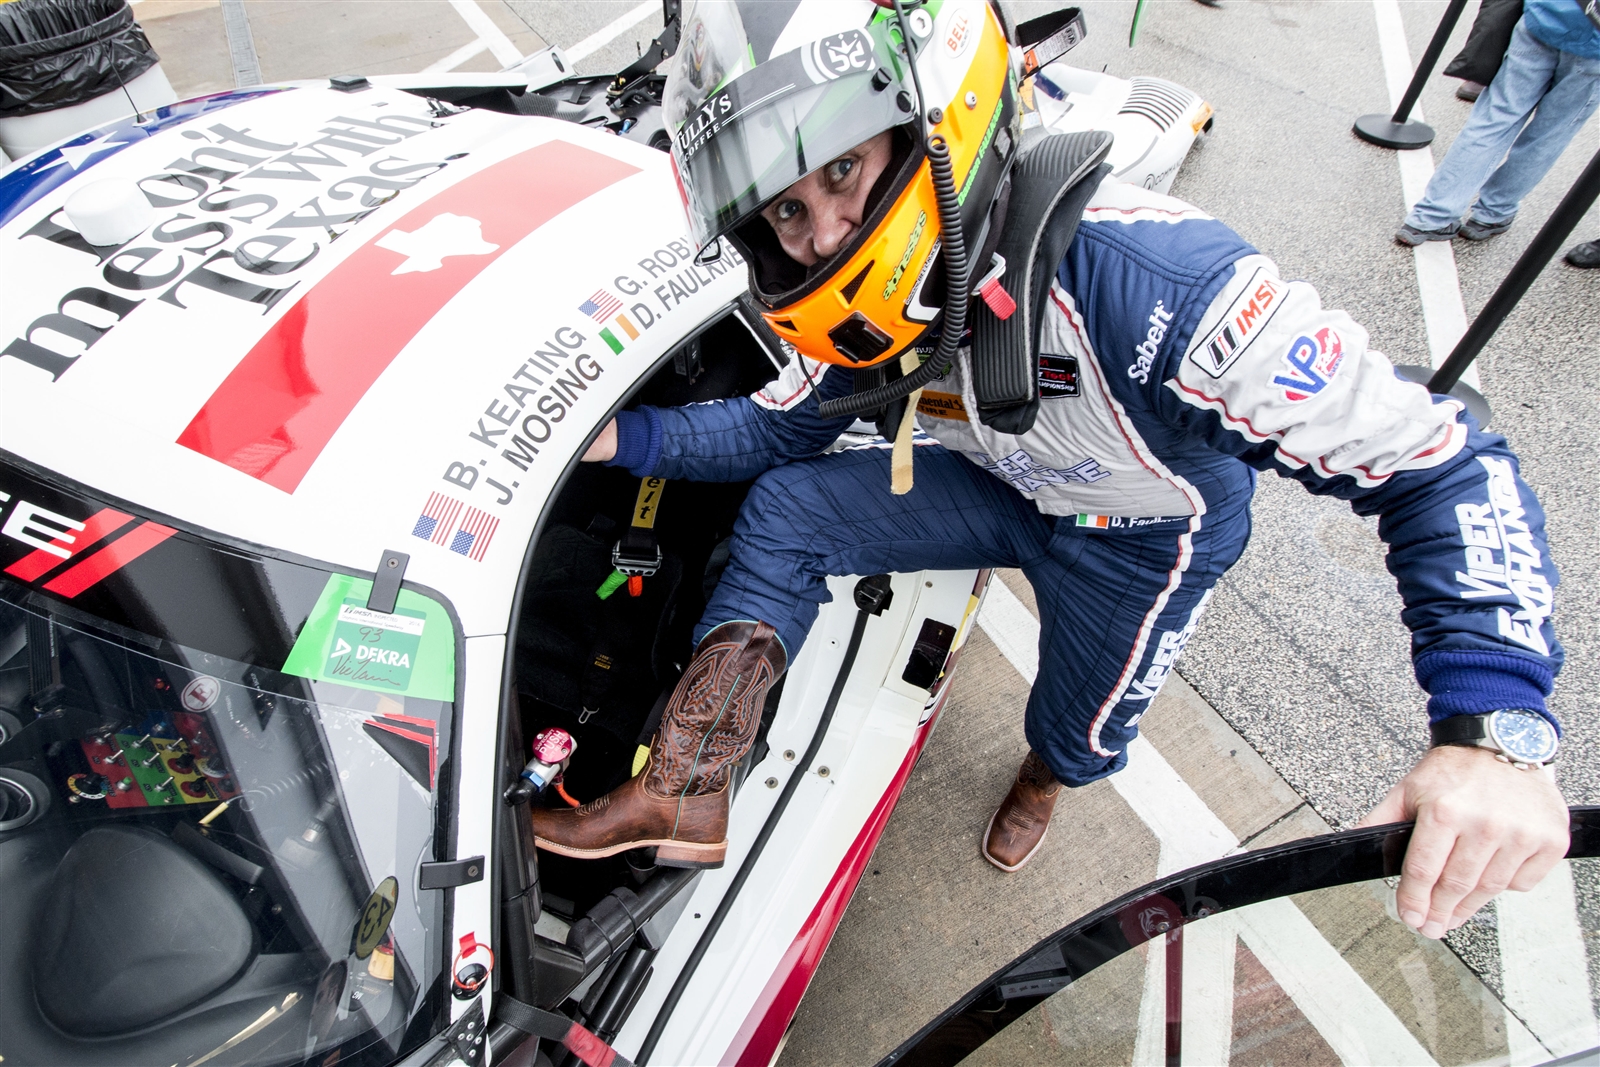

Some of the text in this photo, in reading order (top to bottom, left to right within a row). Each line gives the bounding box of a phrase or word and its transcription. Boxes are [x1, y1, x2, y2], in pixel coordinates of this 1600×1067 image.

[947, 15, 968, 51] BELL
[684, 122, 721, 161] COFFEE
[0, 115, 449, 383] mess with
[157, 152, 470, 316] Texas.
[614, 276, 648, 295] G.
[630, 244, 745, 330] D. FAULKNE
[1235, 279, 1280, 336] IMSA
[1128, 303, 1174, 385] Sabelt
[1273, 336, 1328, 394] VP
[442, 326, 587, 491] B. KEATING
[485, 353, 604, 506] J. MOSING
[919, 405, 948, 416] TIRE
[1111, 516, 1125, 529] D.
[1455, 503, 1513, 599] VIPER
[355, 645, 410, 669] DEKRA
[359, 626, 384, 642] 93
[1123, 630, 1184, 700] VIPER
[188, 683, 214, 706] E
[539, 730, 567, 757] PUSH
